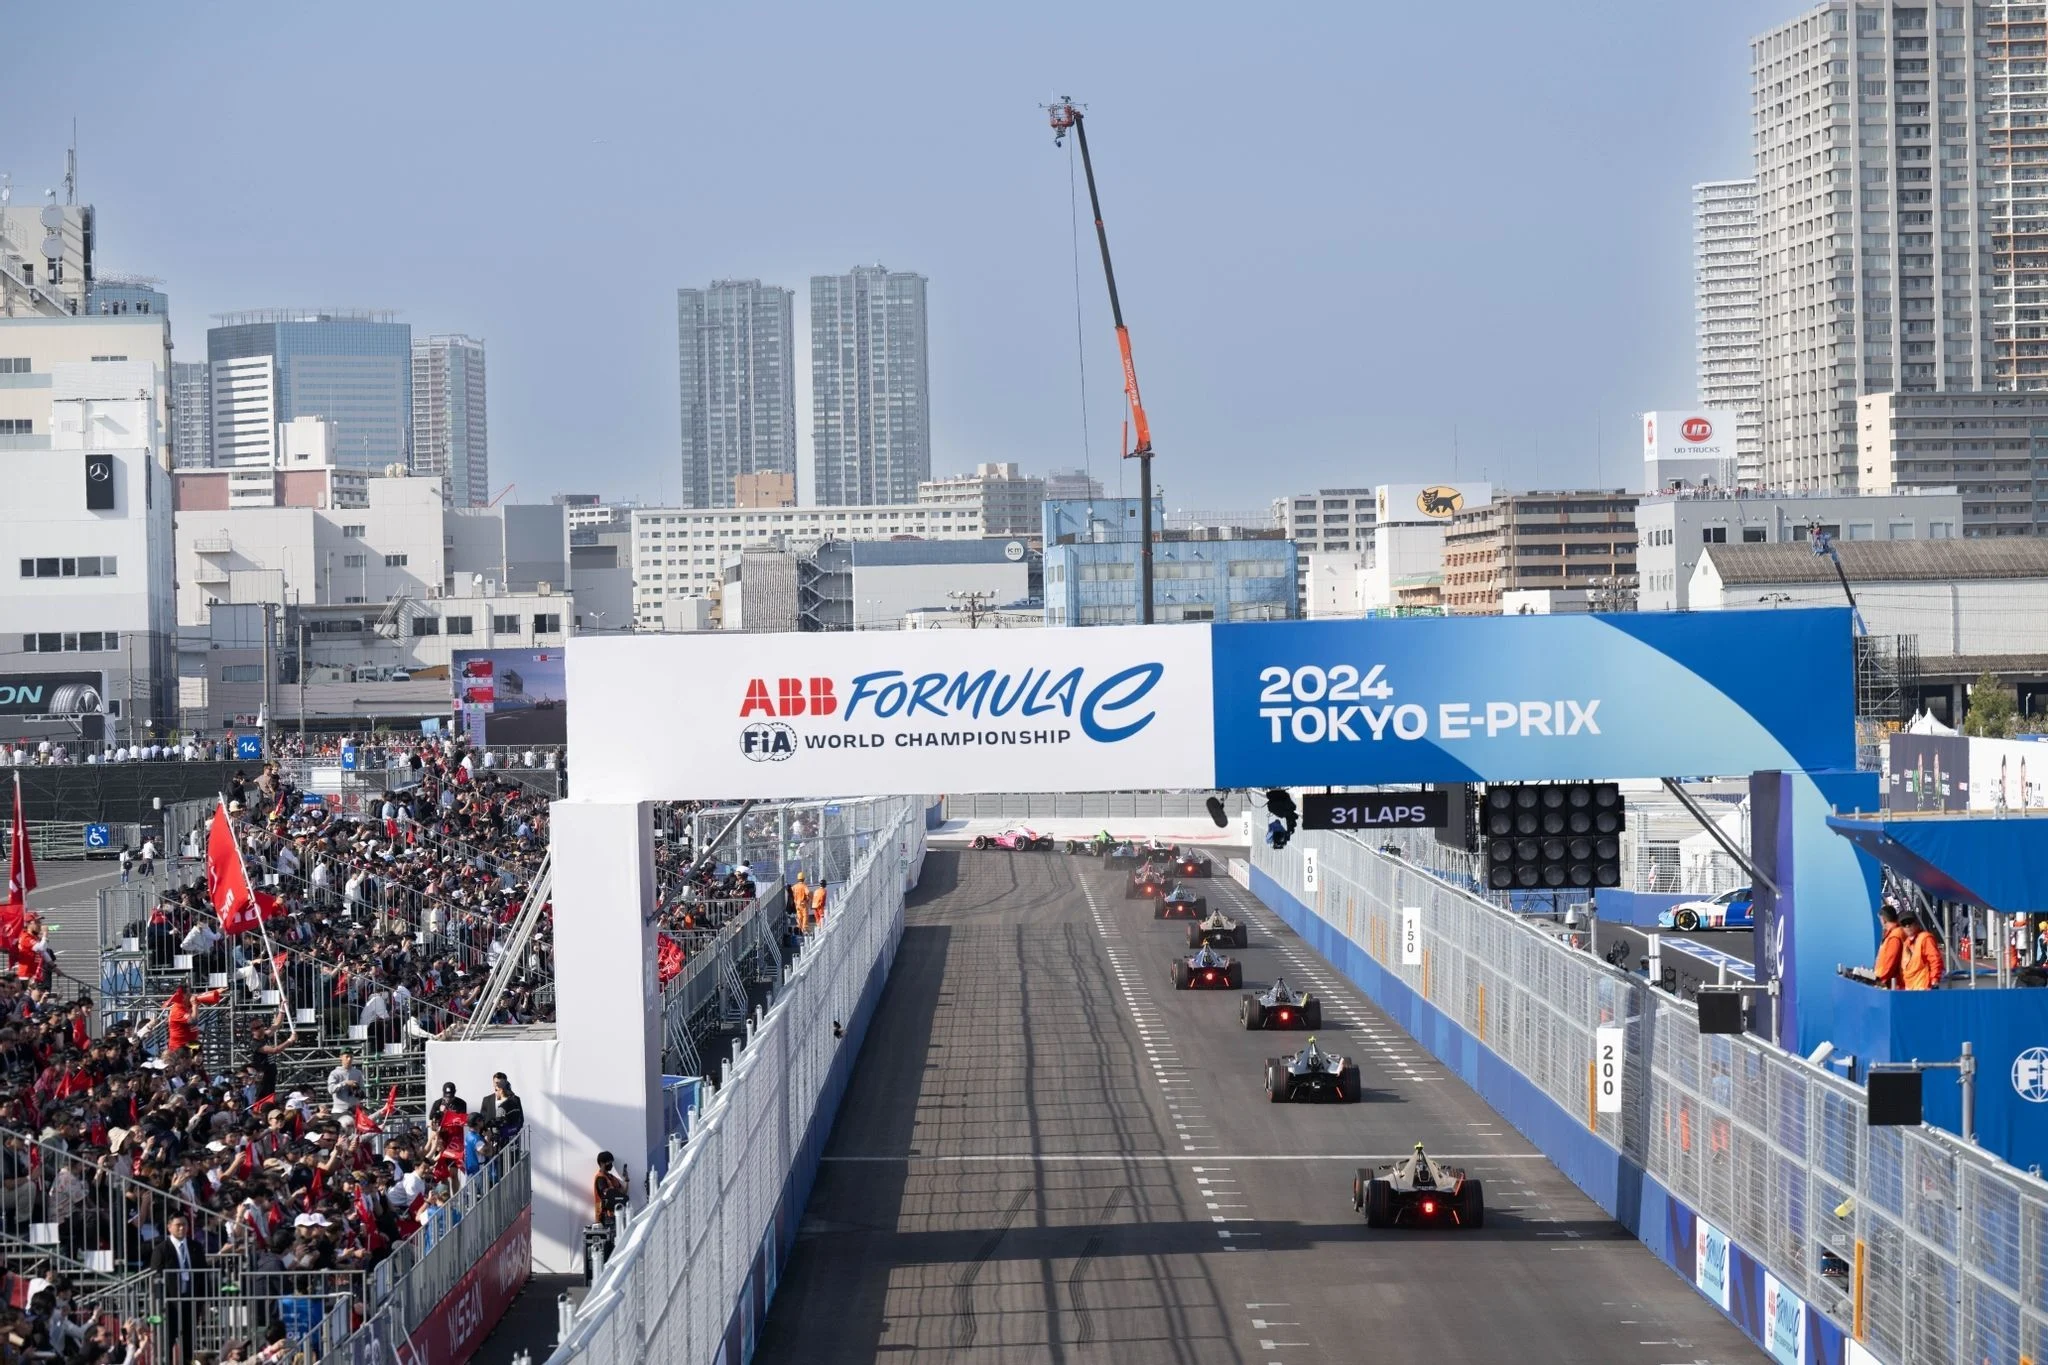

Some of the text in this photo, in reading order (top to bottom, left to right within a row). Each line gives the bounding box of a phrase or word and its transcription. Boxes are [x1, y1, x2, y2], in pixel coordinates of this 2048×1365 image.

[1687, 446, 1721, 454] TRUCKS
[739, 677, 838, 718] ABB
[844, 666, 1084, 722] FORMULA
[1258, 664, 1395, 703] 2024
[1258, 699, 1603, 744] TOKYO E-PRIX
[240, 741, 257, 753] 14
[804, 728, 1072, 750] WORLD CHAMPIONSHIP
[343, 751, 354, 763] 13
[1331, 806, 1427, 825] 31 LAPS
[1406, 919, 1415, 953] 150
[1602, 1044, 1614, 1096] 200
[448, 1280, 484, 1355] NISSAN
